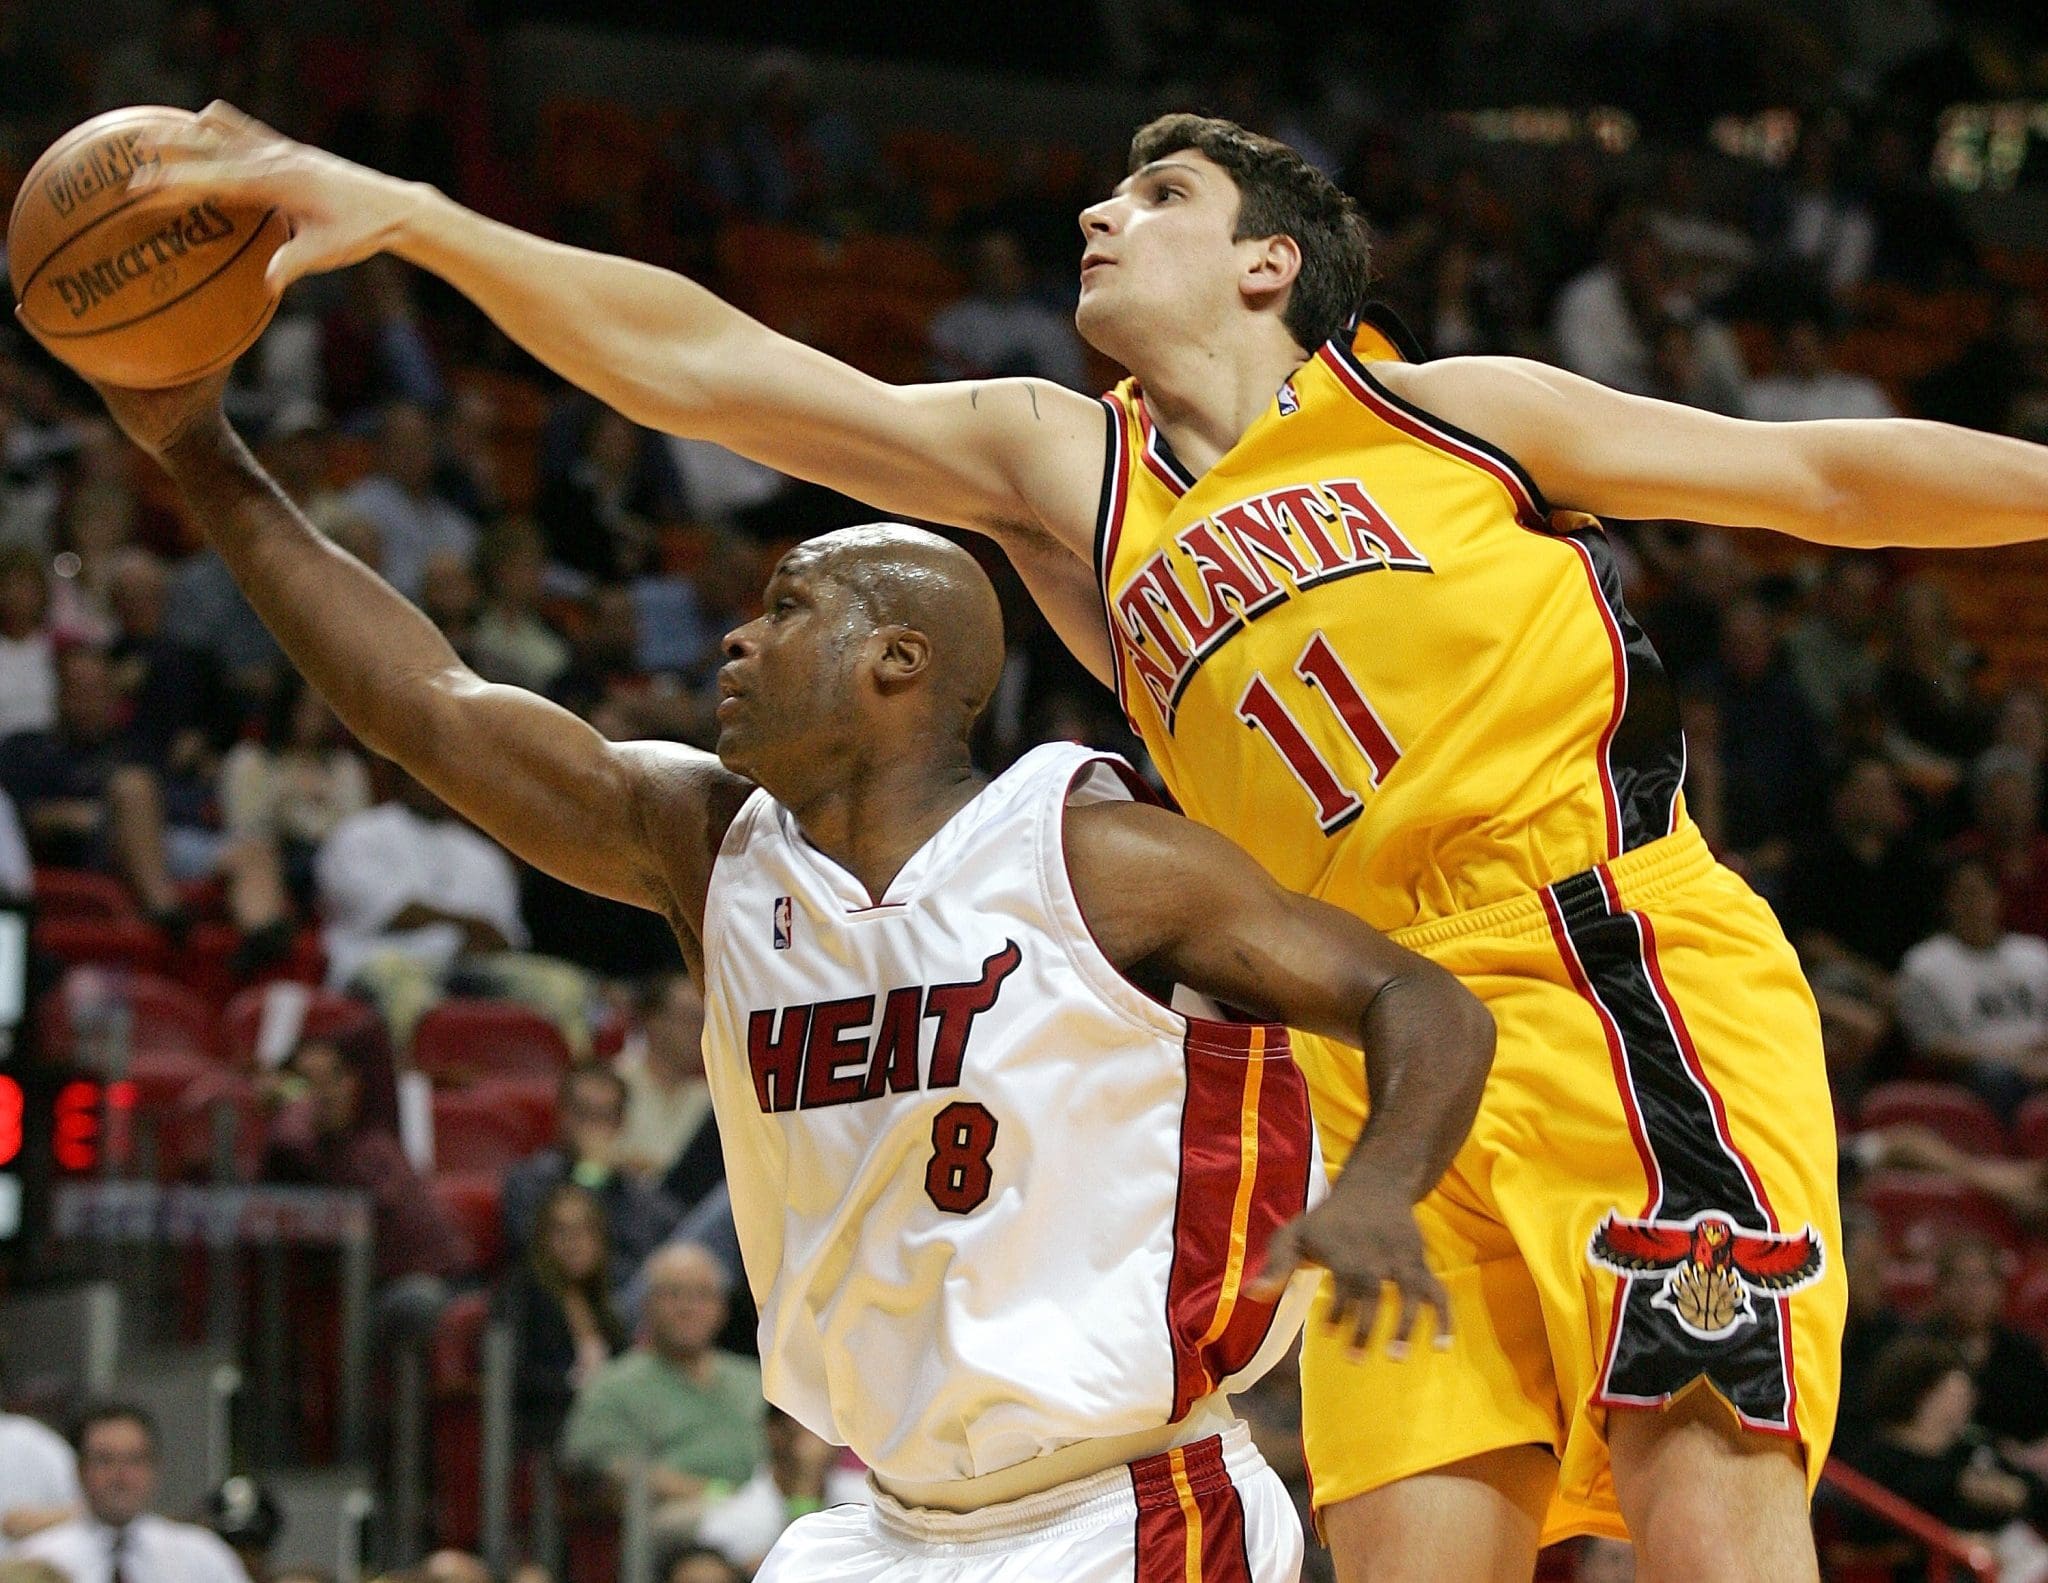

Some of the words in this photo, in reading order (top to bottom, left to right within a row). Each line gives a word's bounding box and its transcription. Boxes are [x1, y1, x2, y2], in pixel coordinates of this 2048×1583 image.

[51, 196, 234, 318] SPALDING
[1115, 478, 1434, 737] ATLANTA
[1235, 628, 1402, 838] 11
[748, 938, 1021, 1113] HEAT
[925, 1101, 998, 1215] 8
